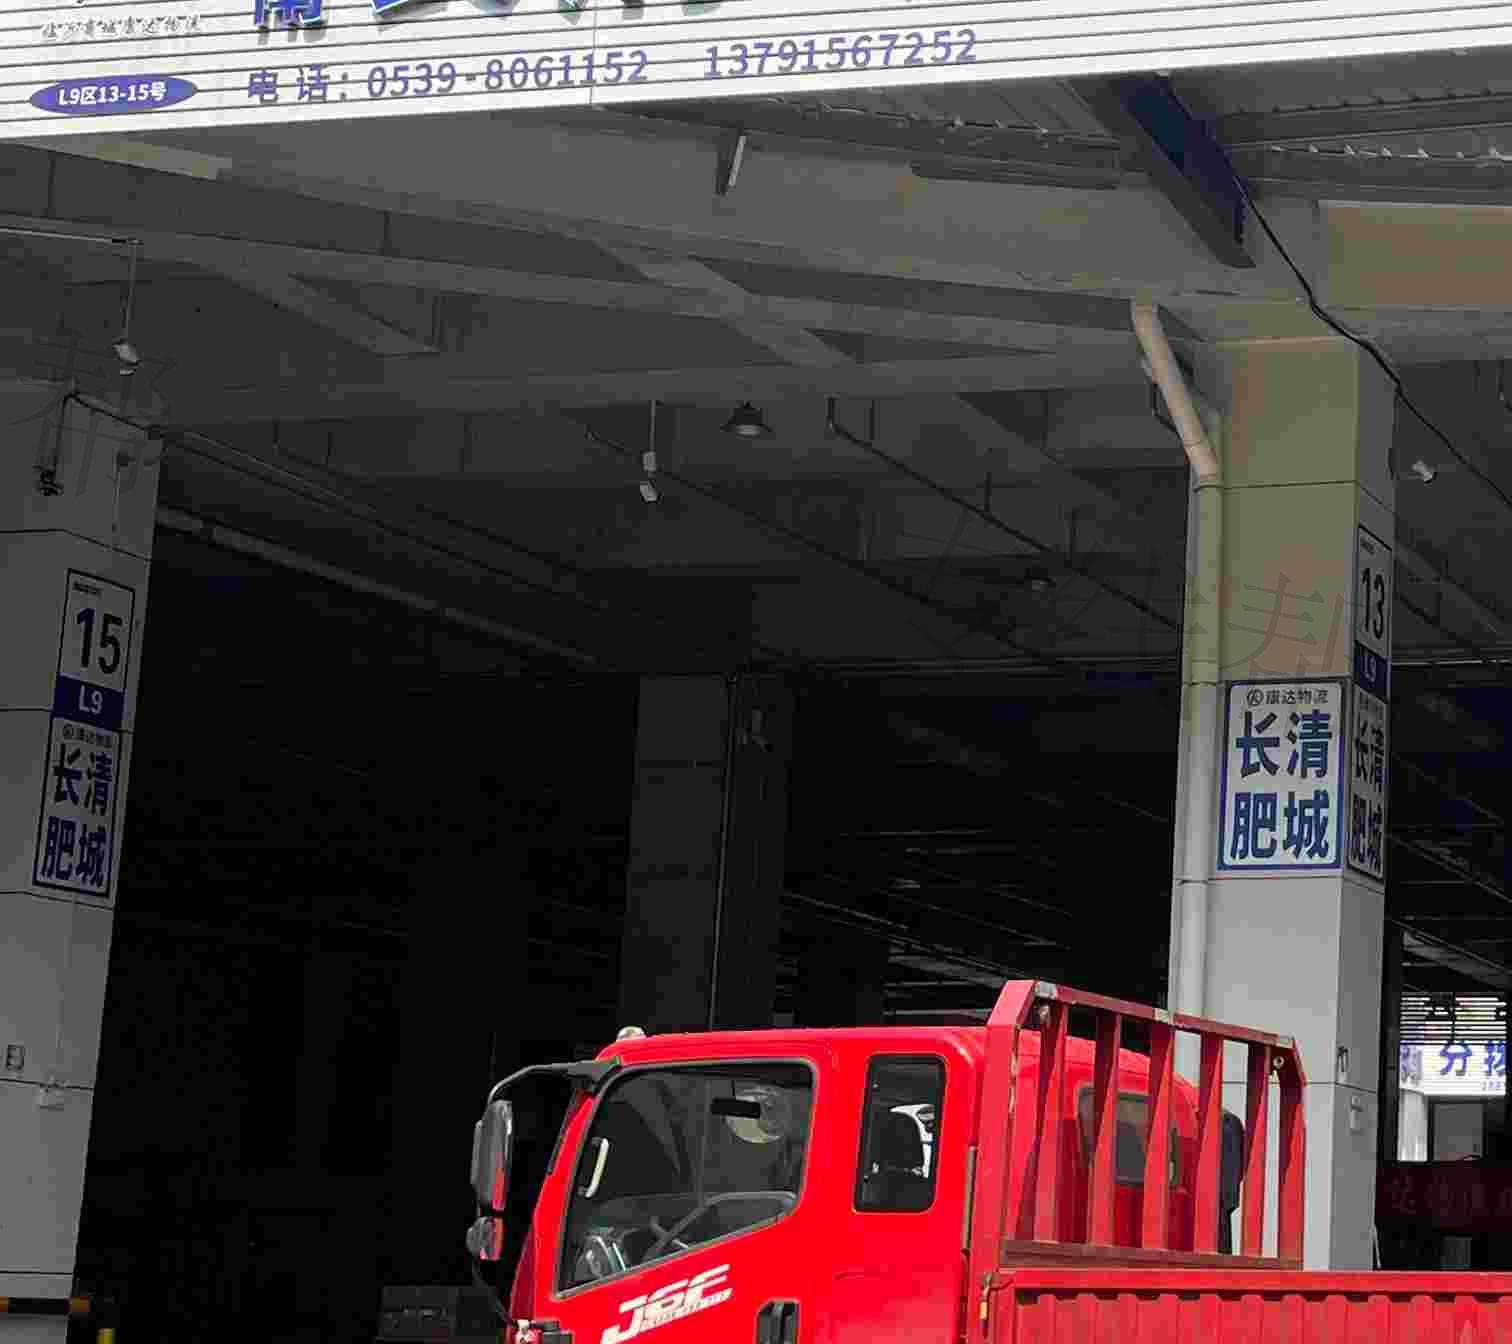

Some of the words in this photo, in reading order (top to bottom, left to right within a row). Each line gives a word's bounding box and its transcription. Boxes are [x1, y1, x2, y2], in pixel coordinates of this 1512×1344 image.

[704, 28, 977, 79] 13791567252
[58, 81, 167, 106] L9区13-15号
[1361, 567, 1386, 640] 13
[77, 607, 122, 675] 15
[78, 684, 103, 714] L9
[1236, 709, 1333, 779] 长清
[53, 744, 113, 815] 长清
[42, 816, 108, 887] 肥城
[1230, 790, 1331, 859] 肥城
